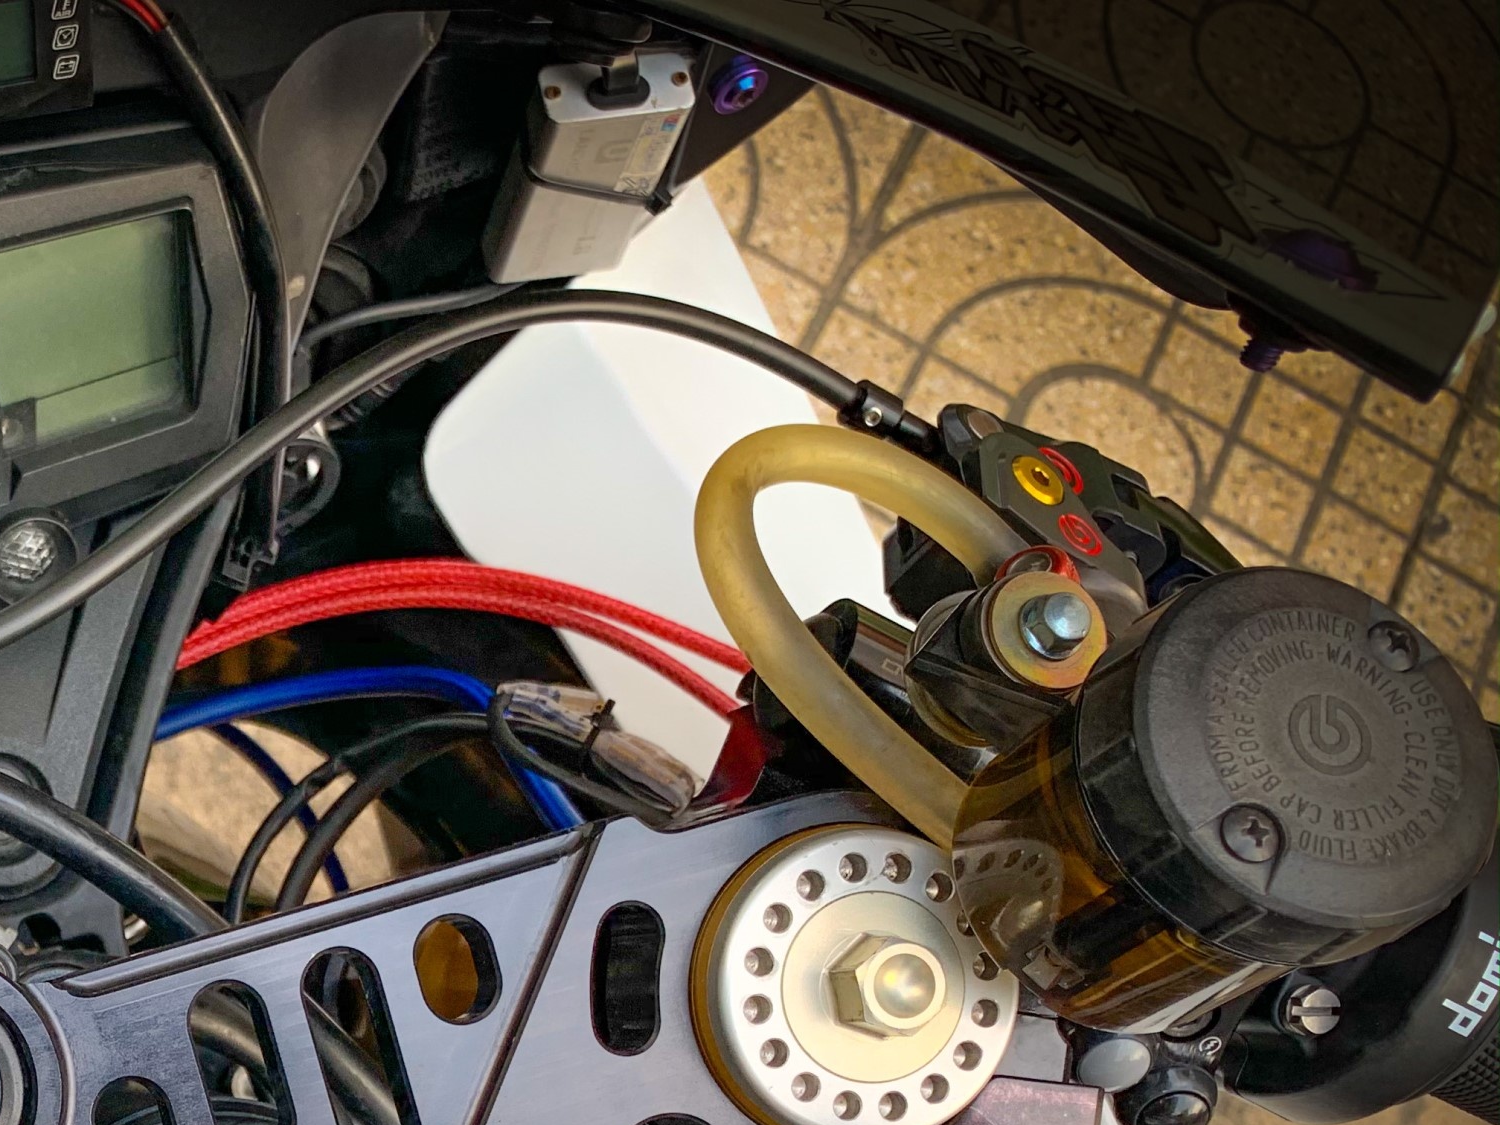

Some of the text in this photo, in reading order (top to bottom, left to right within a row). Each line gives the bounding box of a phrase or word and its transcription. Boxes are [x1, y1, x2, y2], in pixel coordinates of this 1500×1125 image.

[54, 9, 72, 18] AIR
[1250, 611, 1356, 642] CONTAINER
[1211, 635, 1250, 706] SEALED
[1235, 640, 1314, 706] REMOVING
[1327, 642, 1412, 715] WARNING
[1409, 679, 1445, 720] USE
[1207, 715, 1225, 726] A
[1208, 734, 1248, 792] FROM
[1232, 711, 1283, 793] BEFORE
[1397, 731, 1428, 798] CLEAN
[1431, 726, 1458, 775] ONLY
[1279, 793, 1323, 825] CAP
[1333, 794, 1405, 832] FILLER
[1428, 776, 1455, 812] DOT
[1299, 829, 1357, 861] FLUID
[1362, 820, 1427, 859] BRAKE
